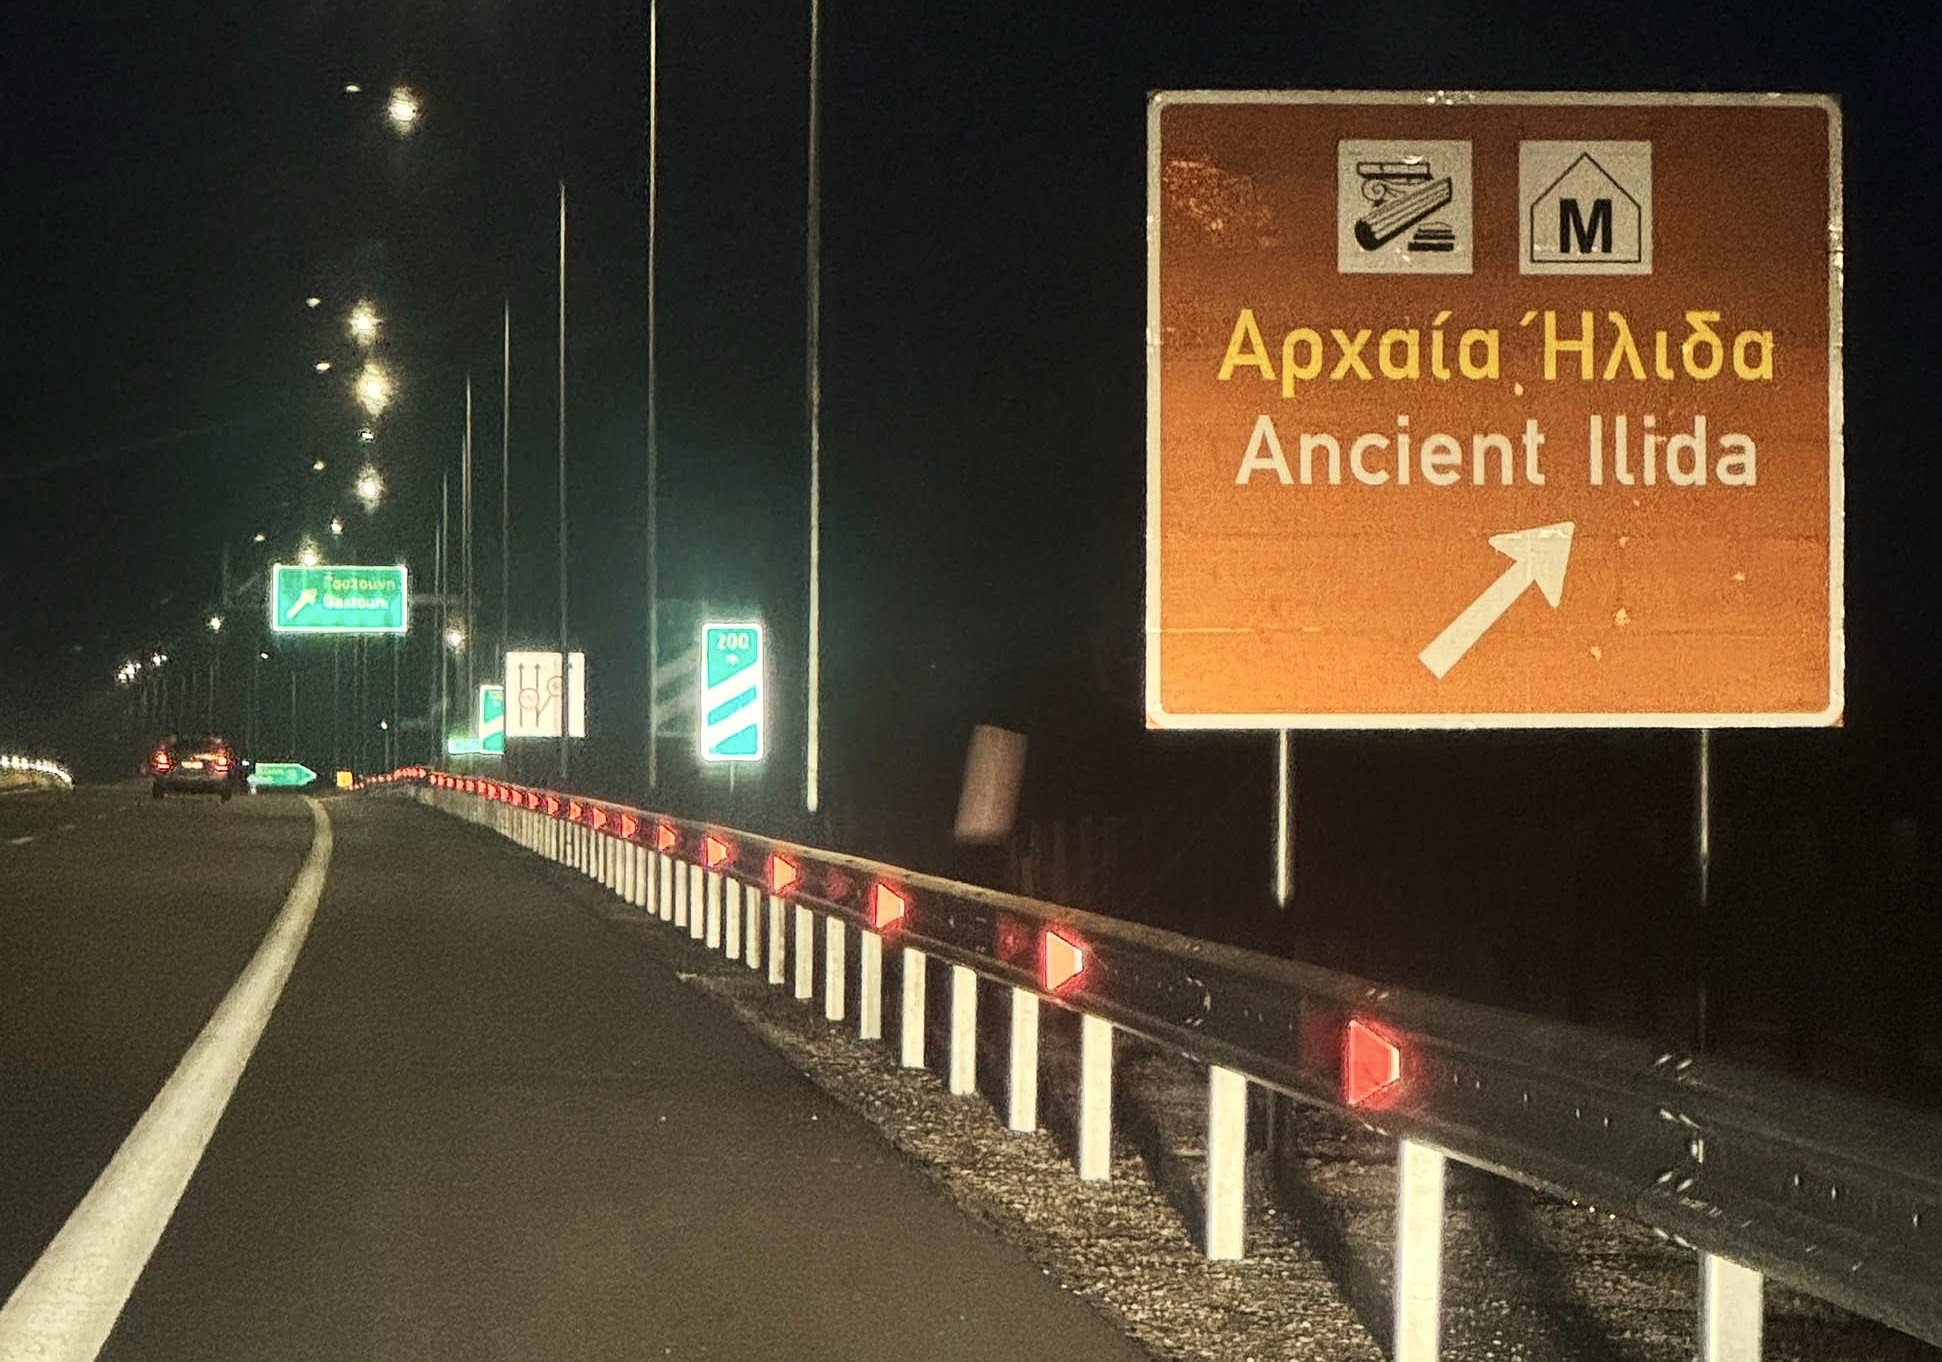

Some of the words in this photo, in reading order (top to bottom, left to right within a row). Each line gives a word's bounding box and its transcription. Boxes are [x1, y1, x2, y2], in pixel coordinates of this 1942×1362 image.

[1559, 199, 1612, 254] M
[1217, 309, 1499, 398] Αρχαία
[1521, 309, 1775, 381] Ήλιδα
[1235, 414, 1546, 486] Ancient
[1590, 415, 1757, 486] Ilida
[717, 633, 750, 651] 200
